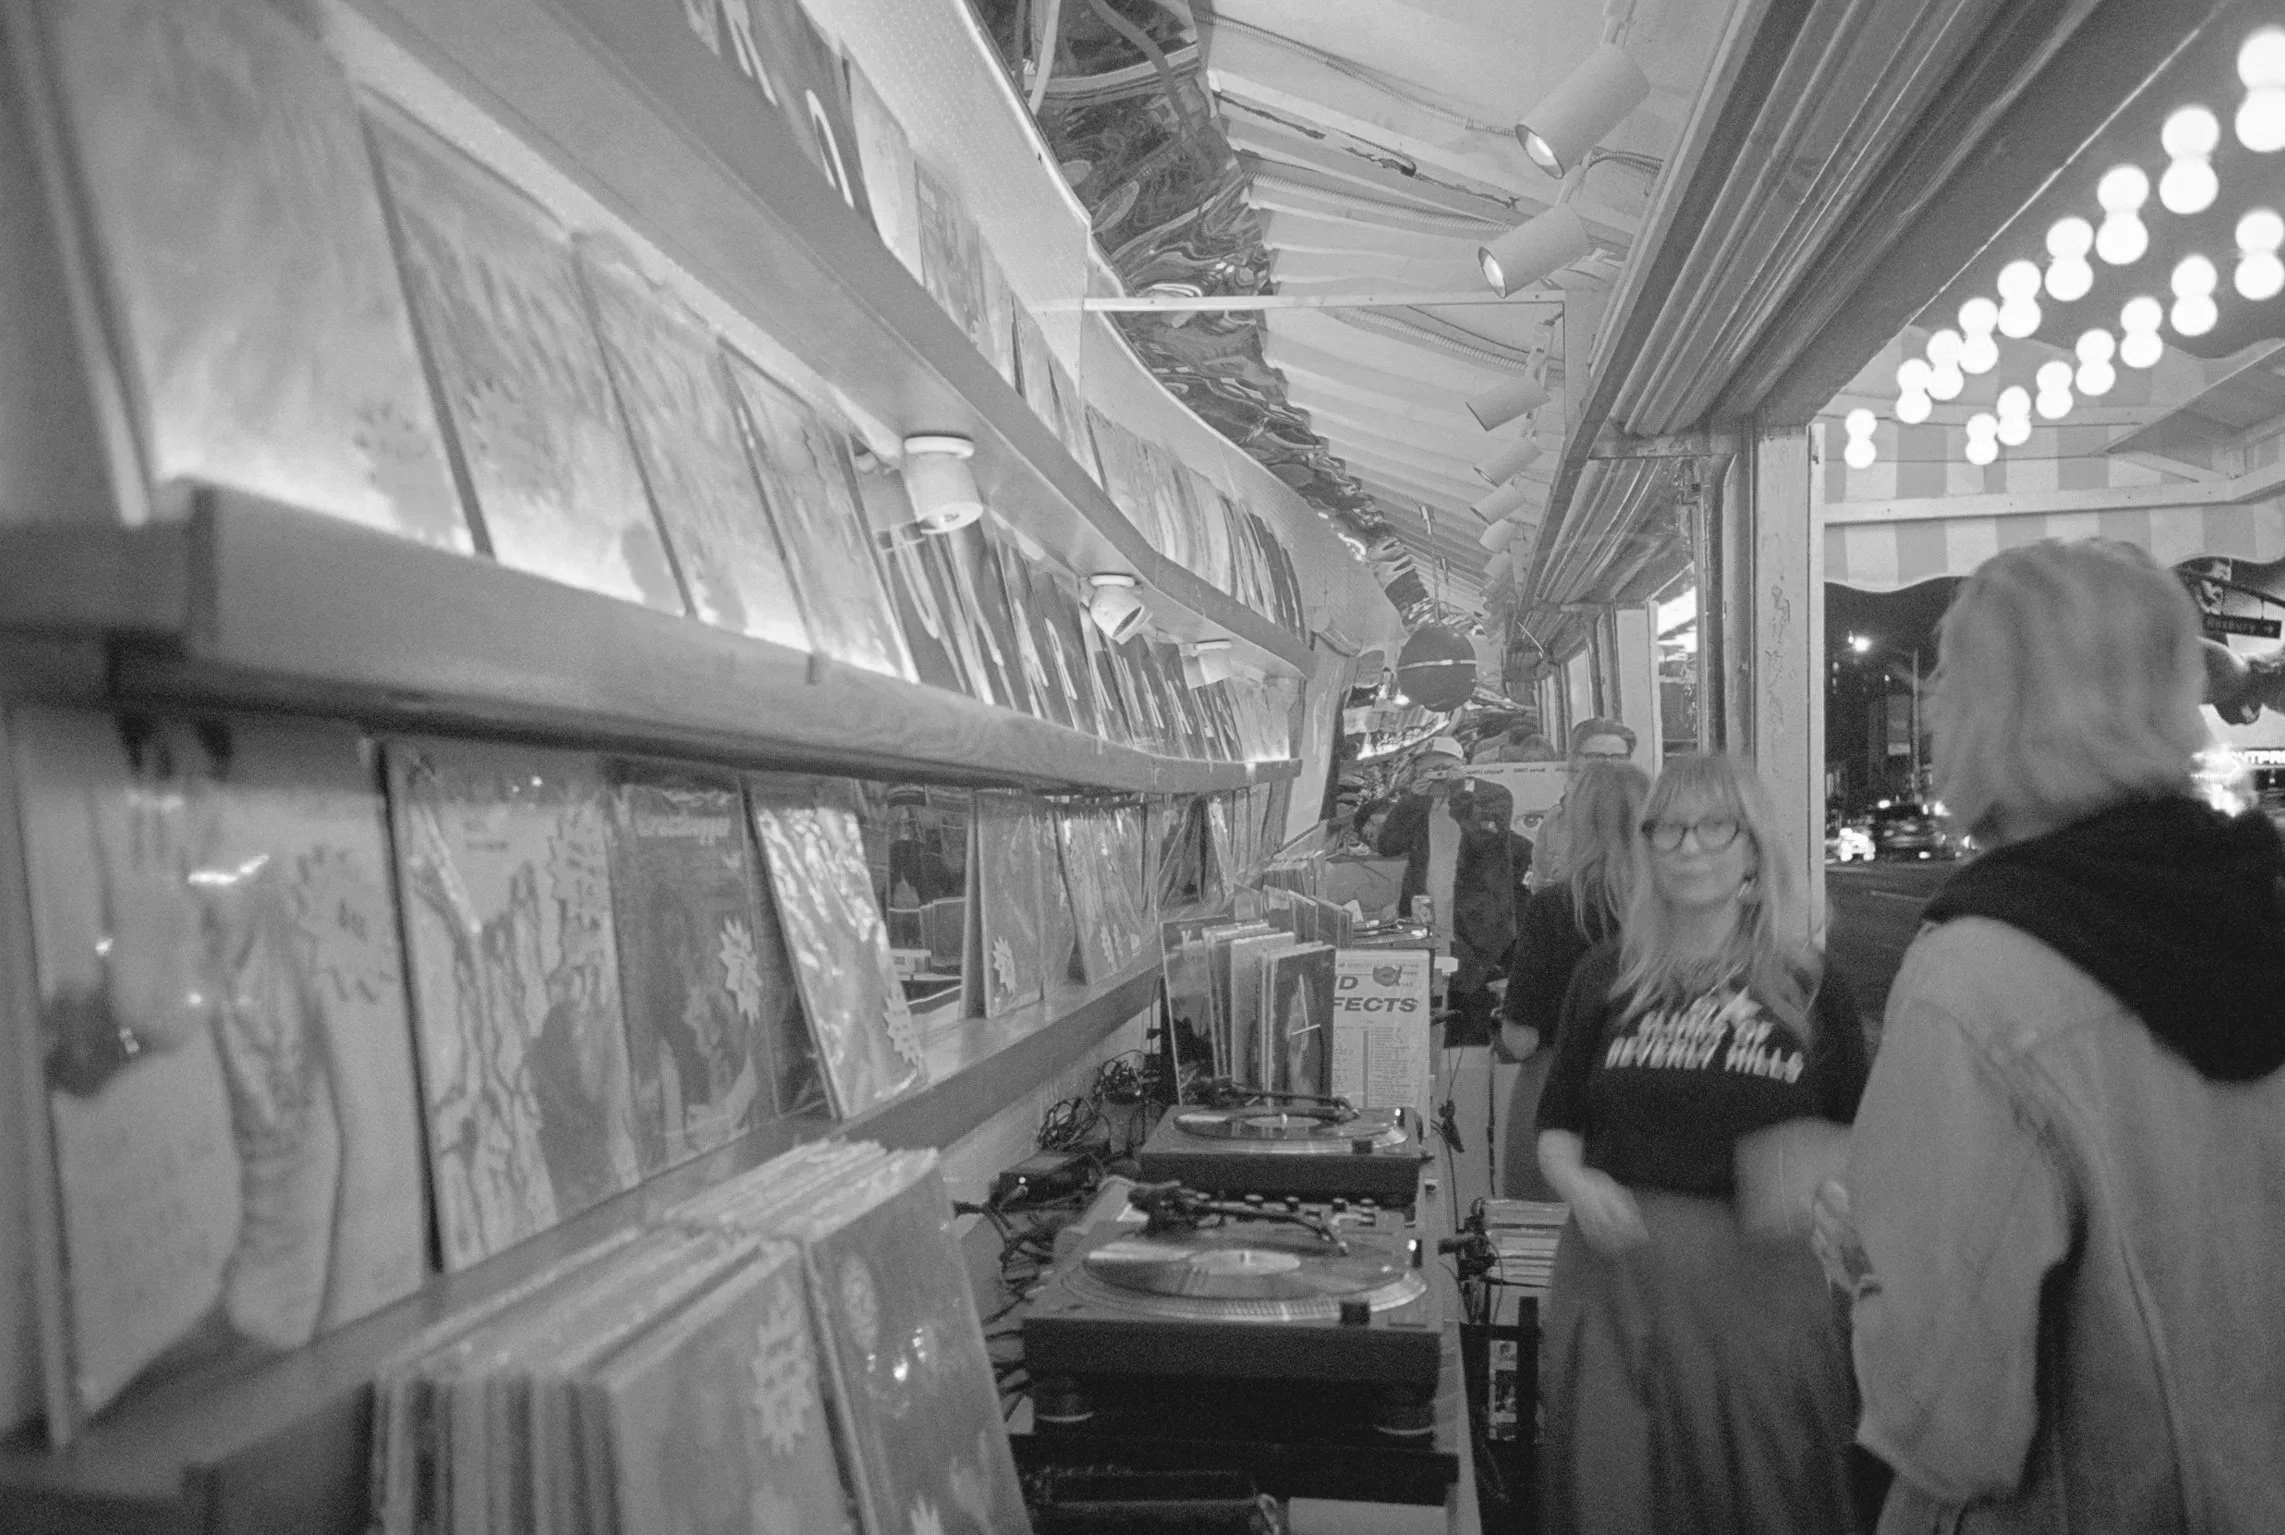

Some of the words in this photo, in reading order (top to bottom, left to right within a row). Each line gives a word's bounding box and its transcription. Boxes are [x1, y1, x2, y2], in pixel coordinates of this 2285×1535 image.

[1335, 975, 1359, 990] D
[1334, 997, 1419, 1012] FECTS
[1605, 1036, 1721, 1070] BEVERLY
[1725, 1040, 1804, 1084] HILLS
